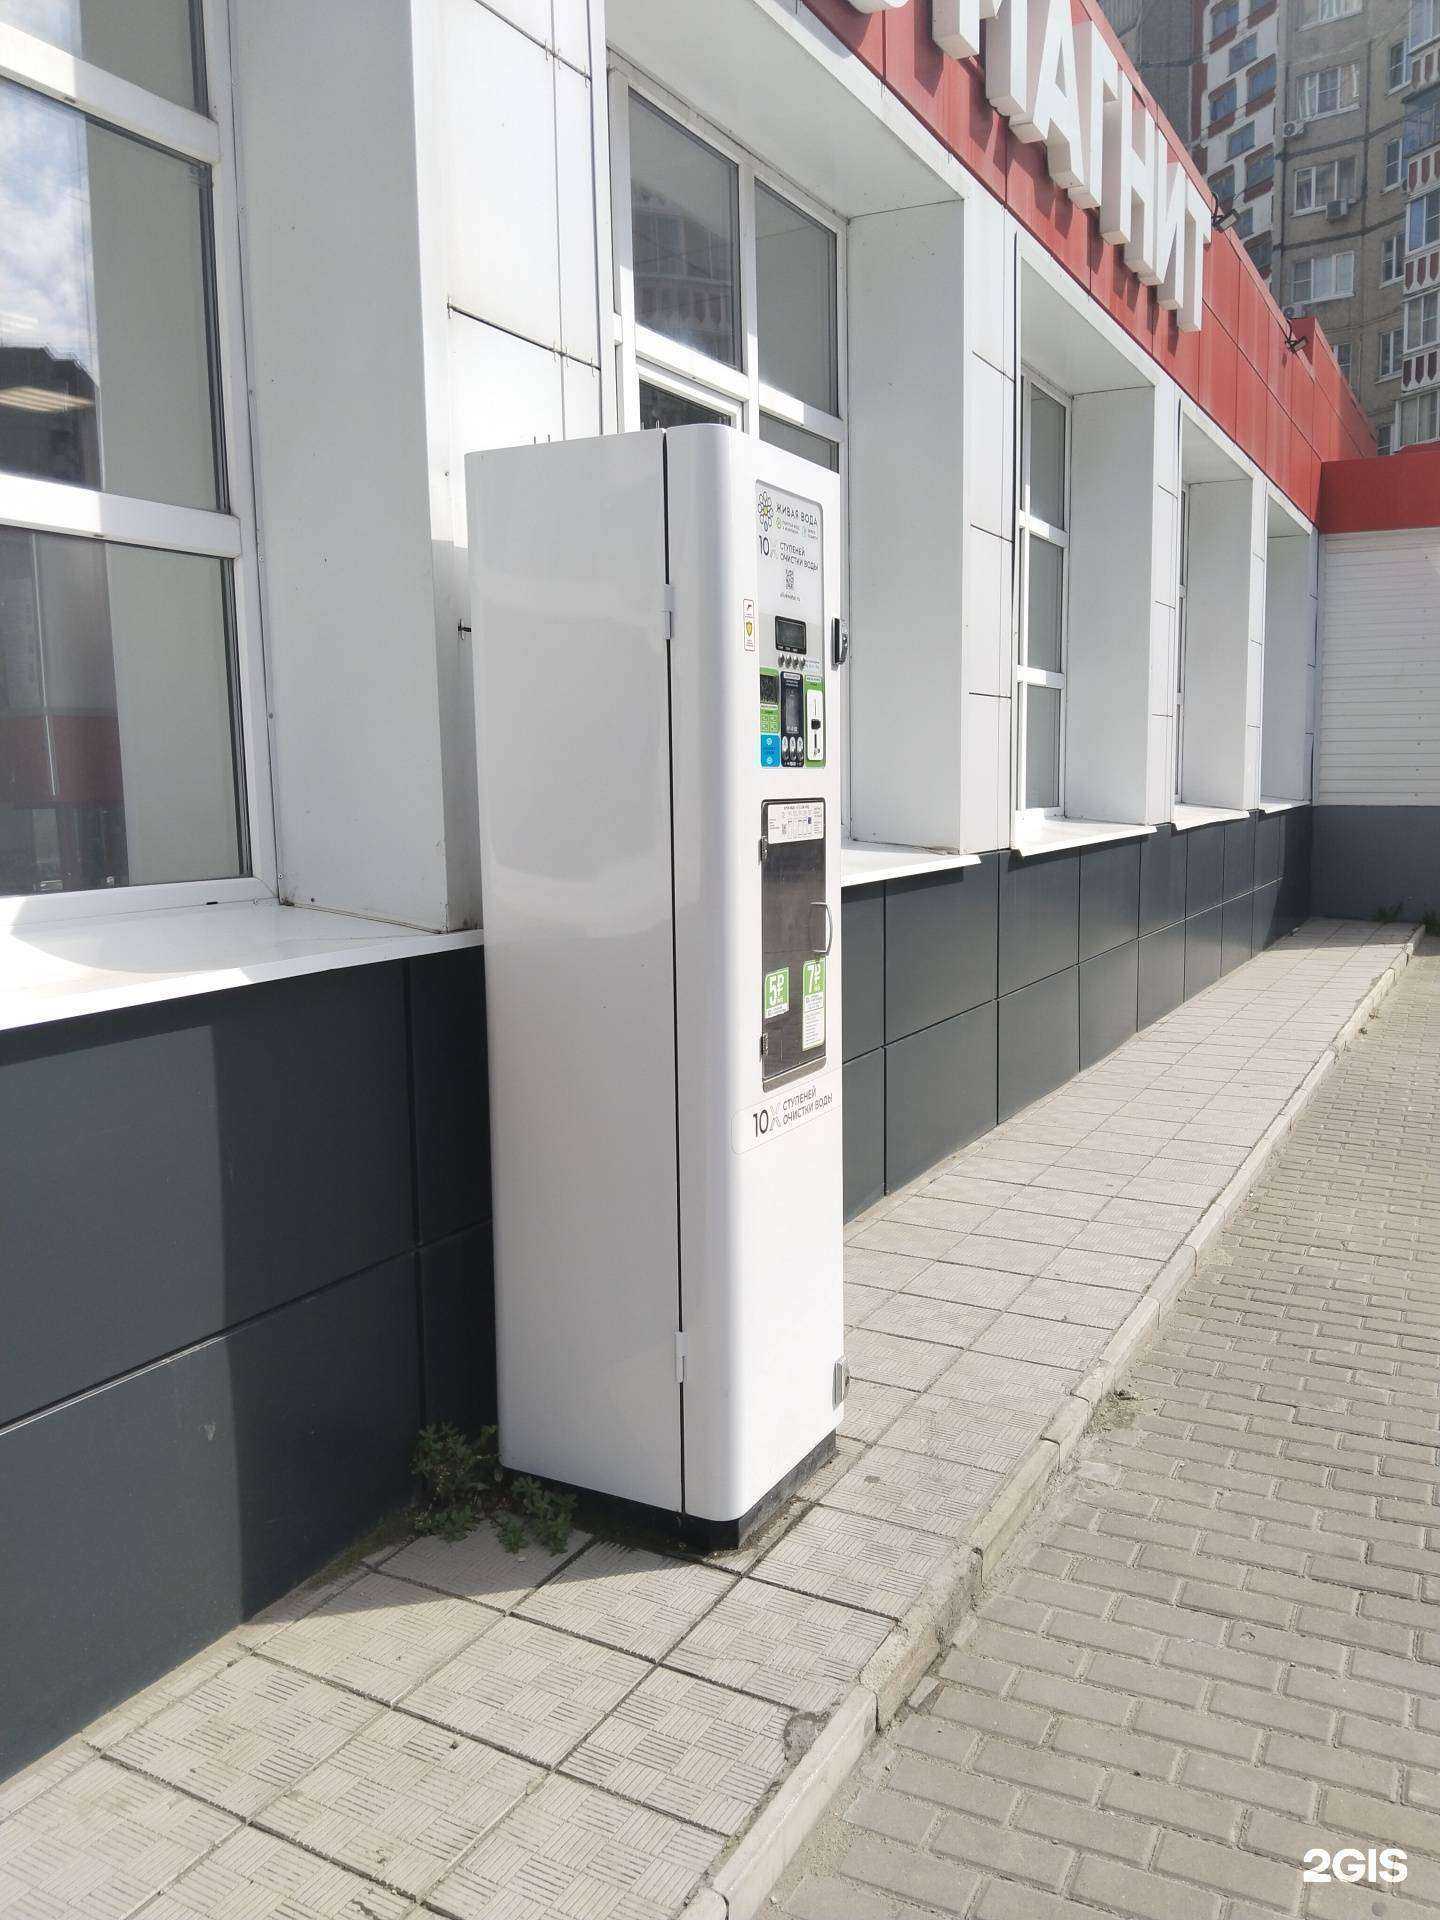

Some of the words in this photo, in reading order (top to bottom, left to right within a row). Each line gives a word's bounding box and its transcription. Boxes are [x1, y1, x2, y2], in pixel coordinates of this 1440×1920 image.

[776, 503, 799, 520] ЖИВАЯ
[801, 513, 818, 527] ВОДА
[780, 542, 806, 557] СТУПЕНЕЙ
[780, 552, 804, 567] ОЧИСТКИ
[804, 559, 819, 571] ВОДЫ
[782, 1086, 816, 1111] СТУПЕНЕЙ
[783, 1101, 814, 1125] ОЧИСТКИ
[815, 1093, 833, 1110] ВОДЫ
